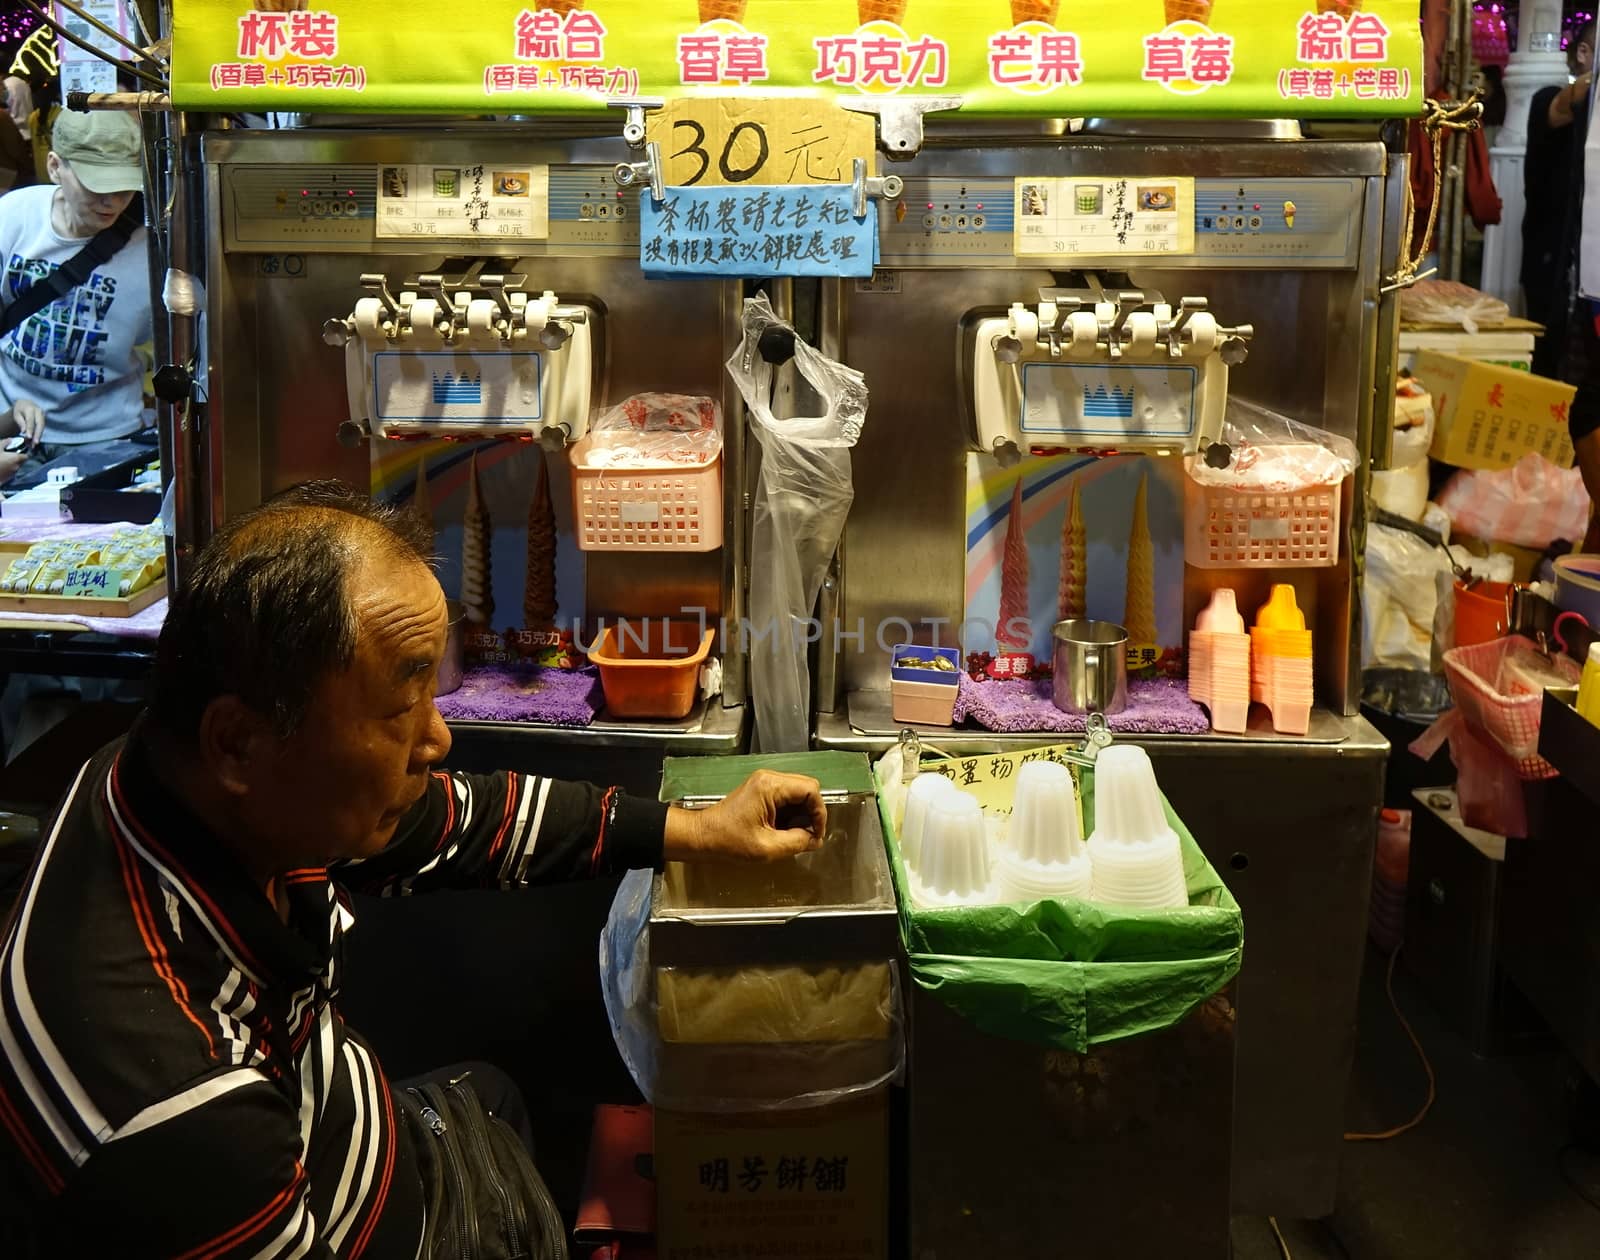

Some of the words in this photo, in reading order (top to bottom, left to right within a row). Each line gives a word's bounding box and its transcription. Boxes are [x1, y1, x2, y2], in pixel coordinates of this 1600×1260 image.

[239, 13, 336, 56] 杯裝
[517, 12, 605, 58] 綜合
[1299, 15, 1388, 60] 綜合
[212, 64, 366, 90] (香草+巧克力)
[485, 66, 638, 95] (香草+巧克力)
[680, 36, 768, 83] 香草
[815, 37, 946, 84] 巧克力
[991, 35, 1080, 83] 芒果
[1145, 37, 1232, 82] 草莓
[1278, 70, 1410, 98] (草莓+芒果)
[518, 630, 561, 646] 巧克力
[993, 656, 1029, 674] 草莓
